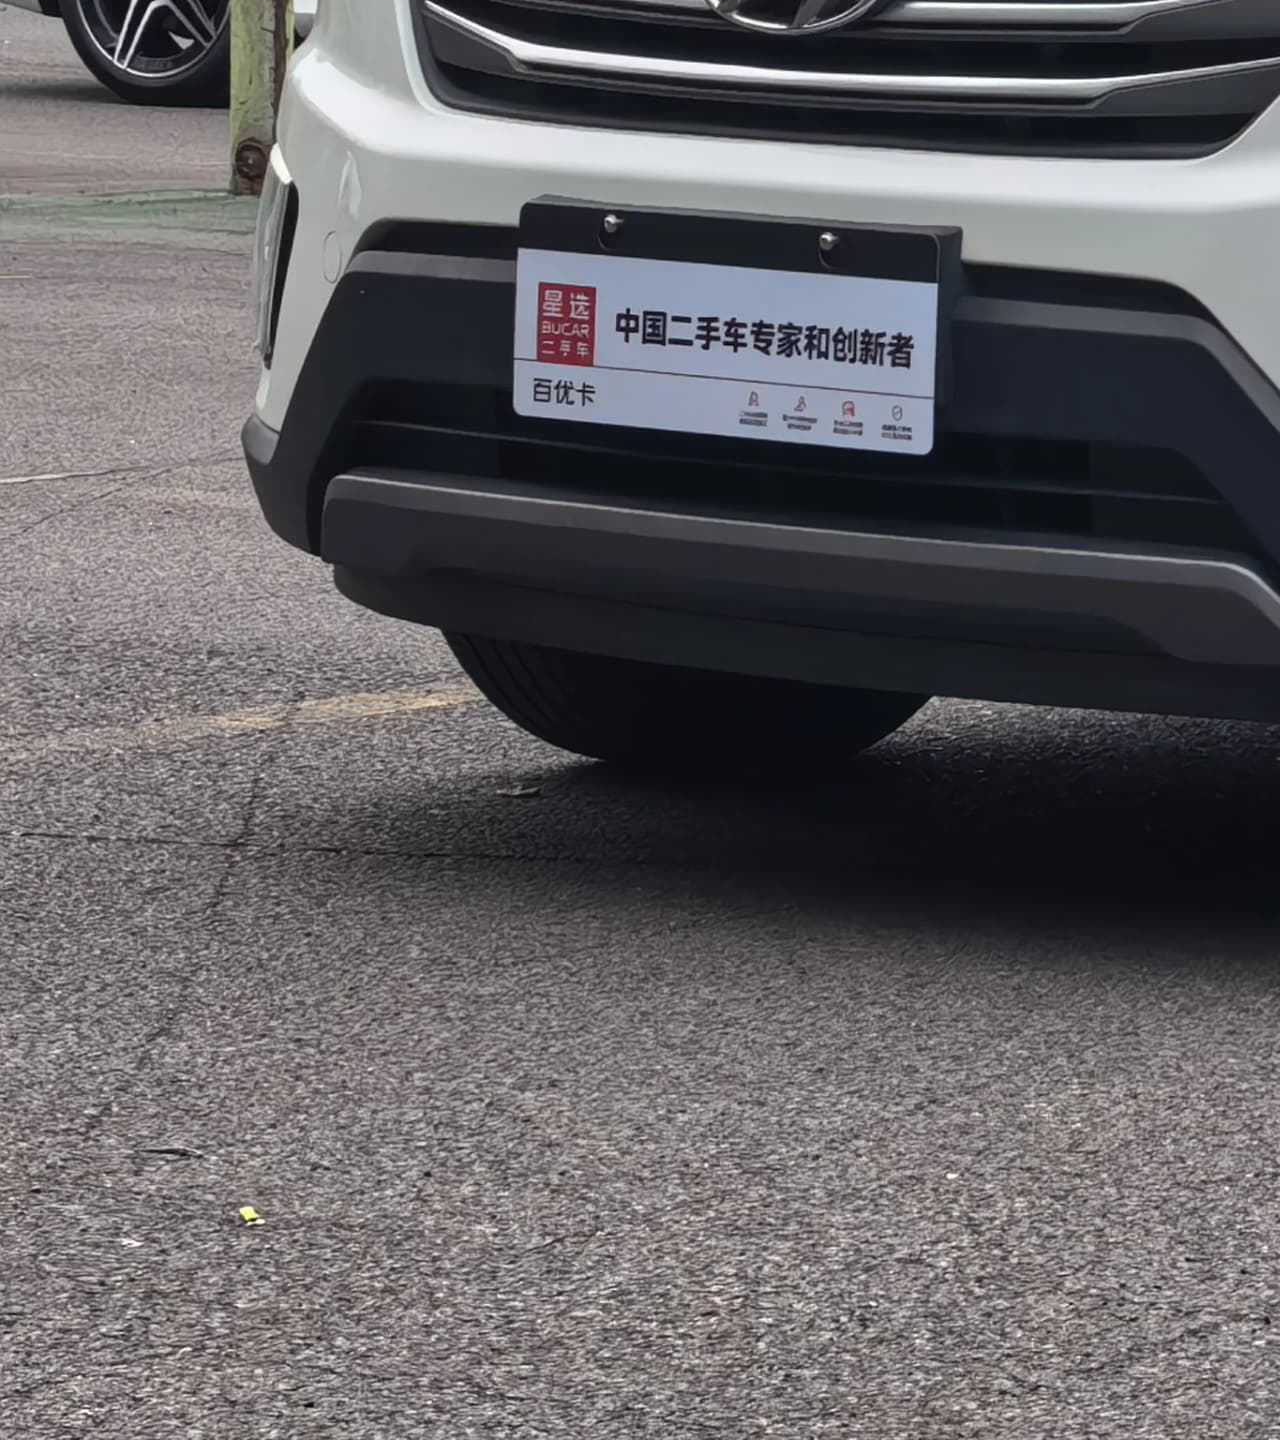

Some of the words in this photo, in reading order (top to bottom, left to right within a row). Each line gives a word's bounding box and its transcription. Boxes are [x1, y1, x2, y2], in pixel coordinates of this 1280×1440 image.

[542, 289, 591, 321] 星选
[541, 320, 590, 339] BUCAR
[615, 307, 915, 369] 中国二手车专家和创新者
[541, 339, 590, 360] 二手车
[533, 377, 597, 408] 百优卡
